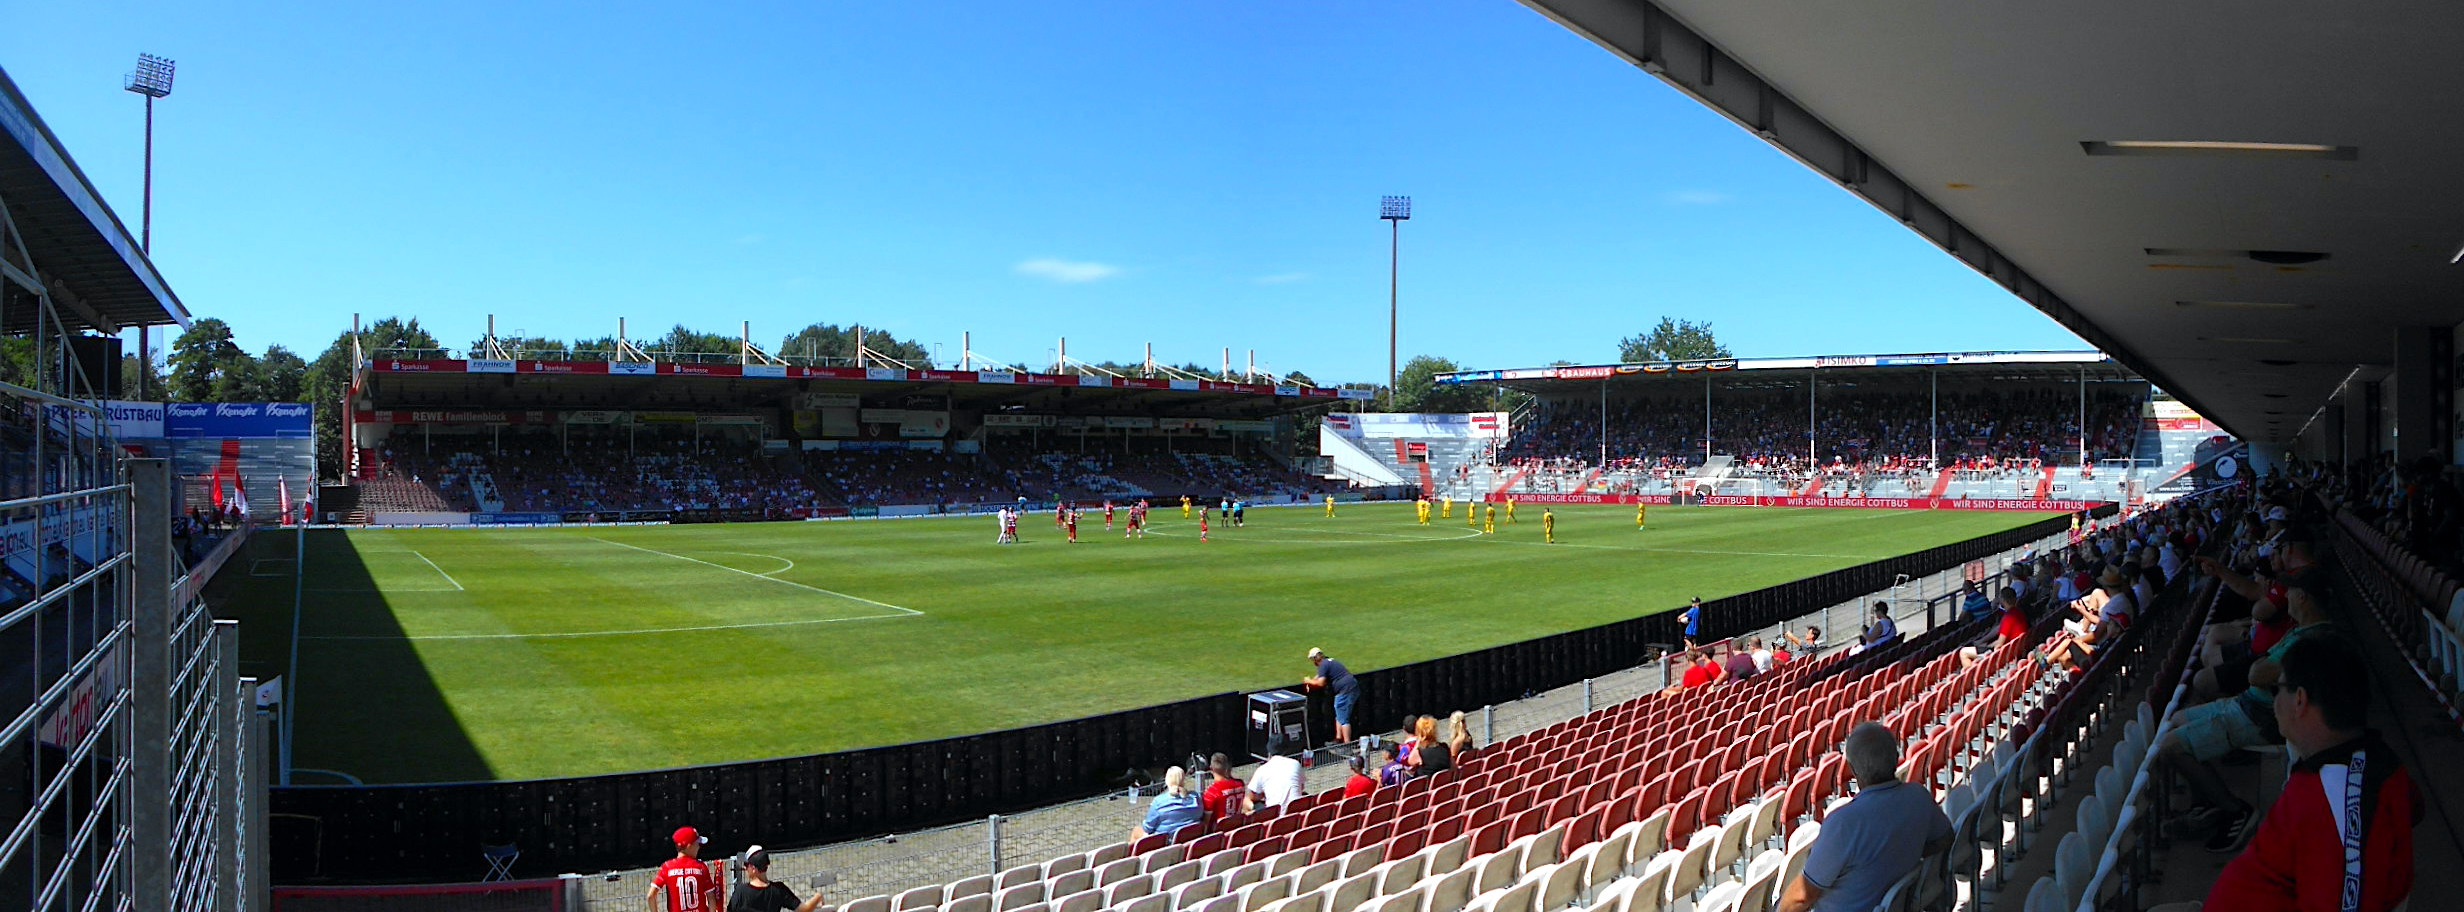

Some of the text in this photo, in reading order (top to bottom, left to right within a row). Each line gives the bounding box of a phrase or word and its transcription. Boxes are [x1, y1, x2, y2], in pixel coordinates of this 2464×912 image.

[401, 363, 429, 371] Sparkasse
[1566, 369, 1611, 378] BAUHAUS
[412, 412, 443, 421] REWE
[1520, 494, 1536, 502] SIND
[1568, 495, 1602, 503] COTTBUS
[1709, 497, 1747, 505] COTTBUS
[1787, 497, 1909, 508] WIR SIND ENERGIE COTTBUS
[1952, 500, 2084, 510] WIR SIND ENERGIE COTTBUS
[676, 876, 699, 911] 10
